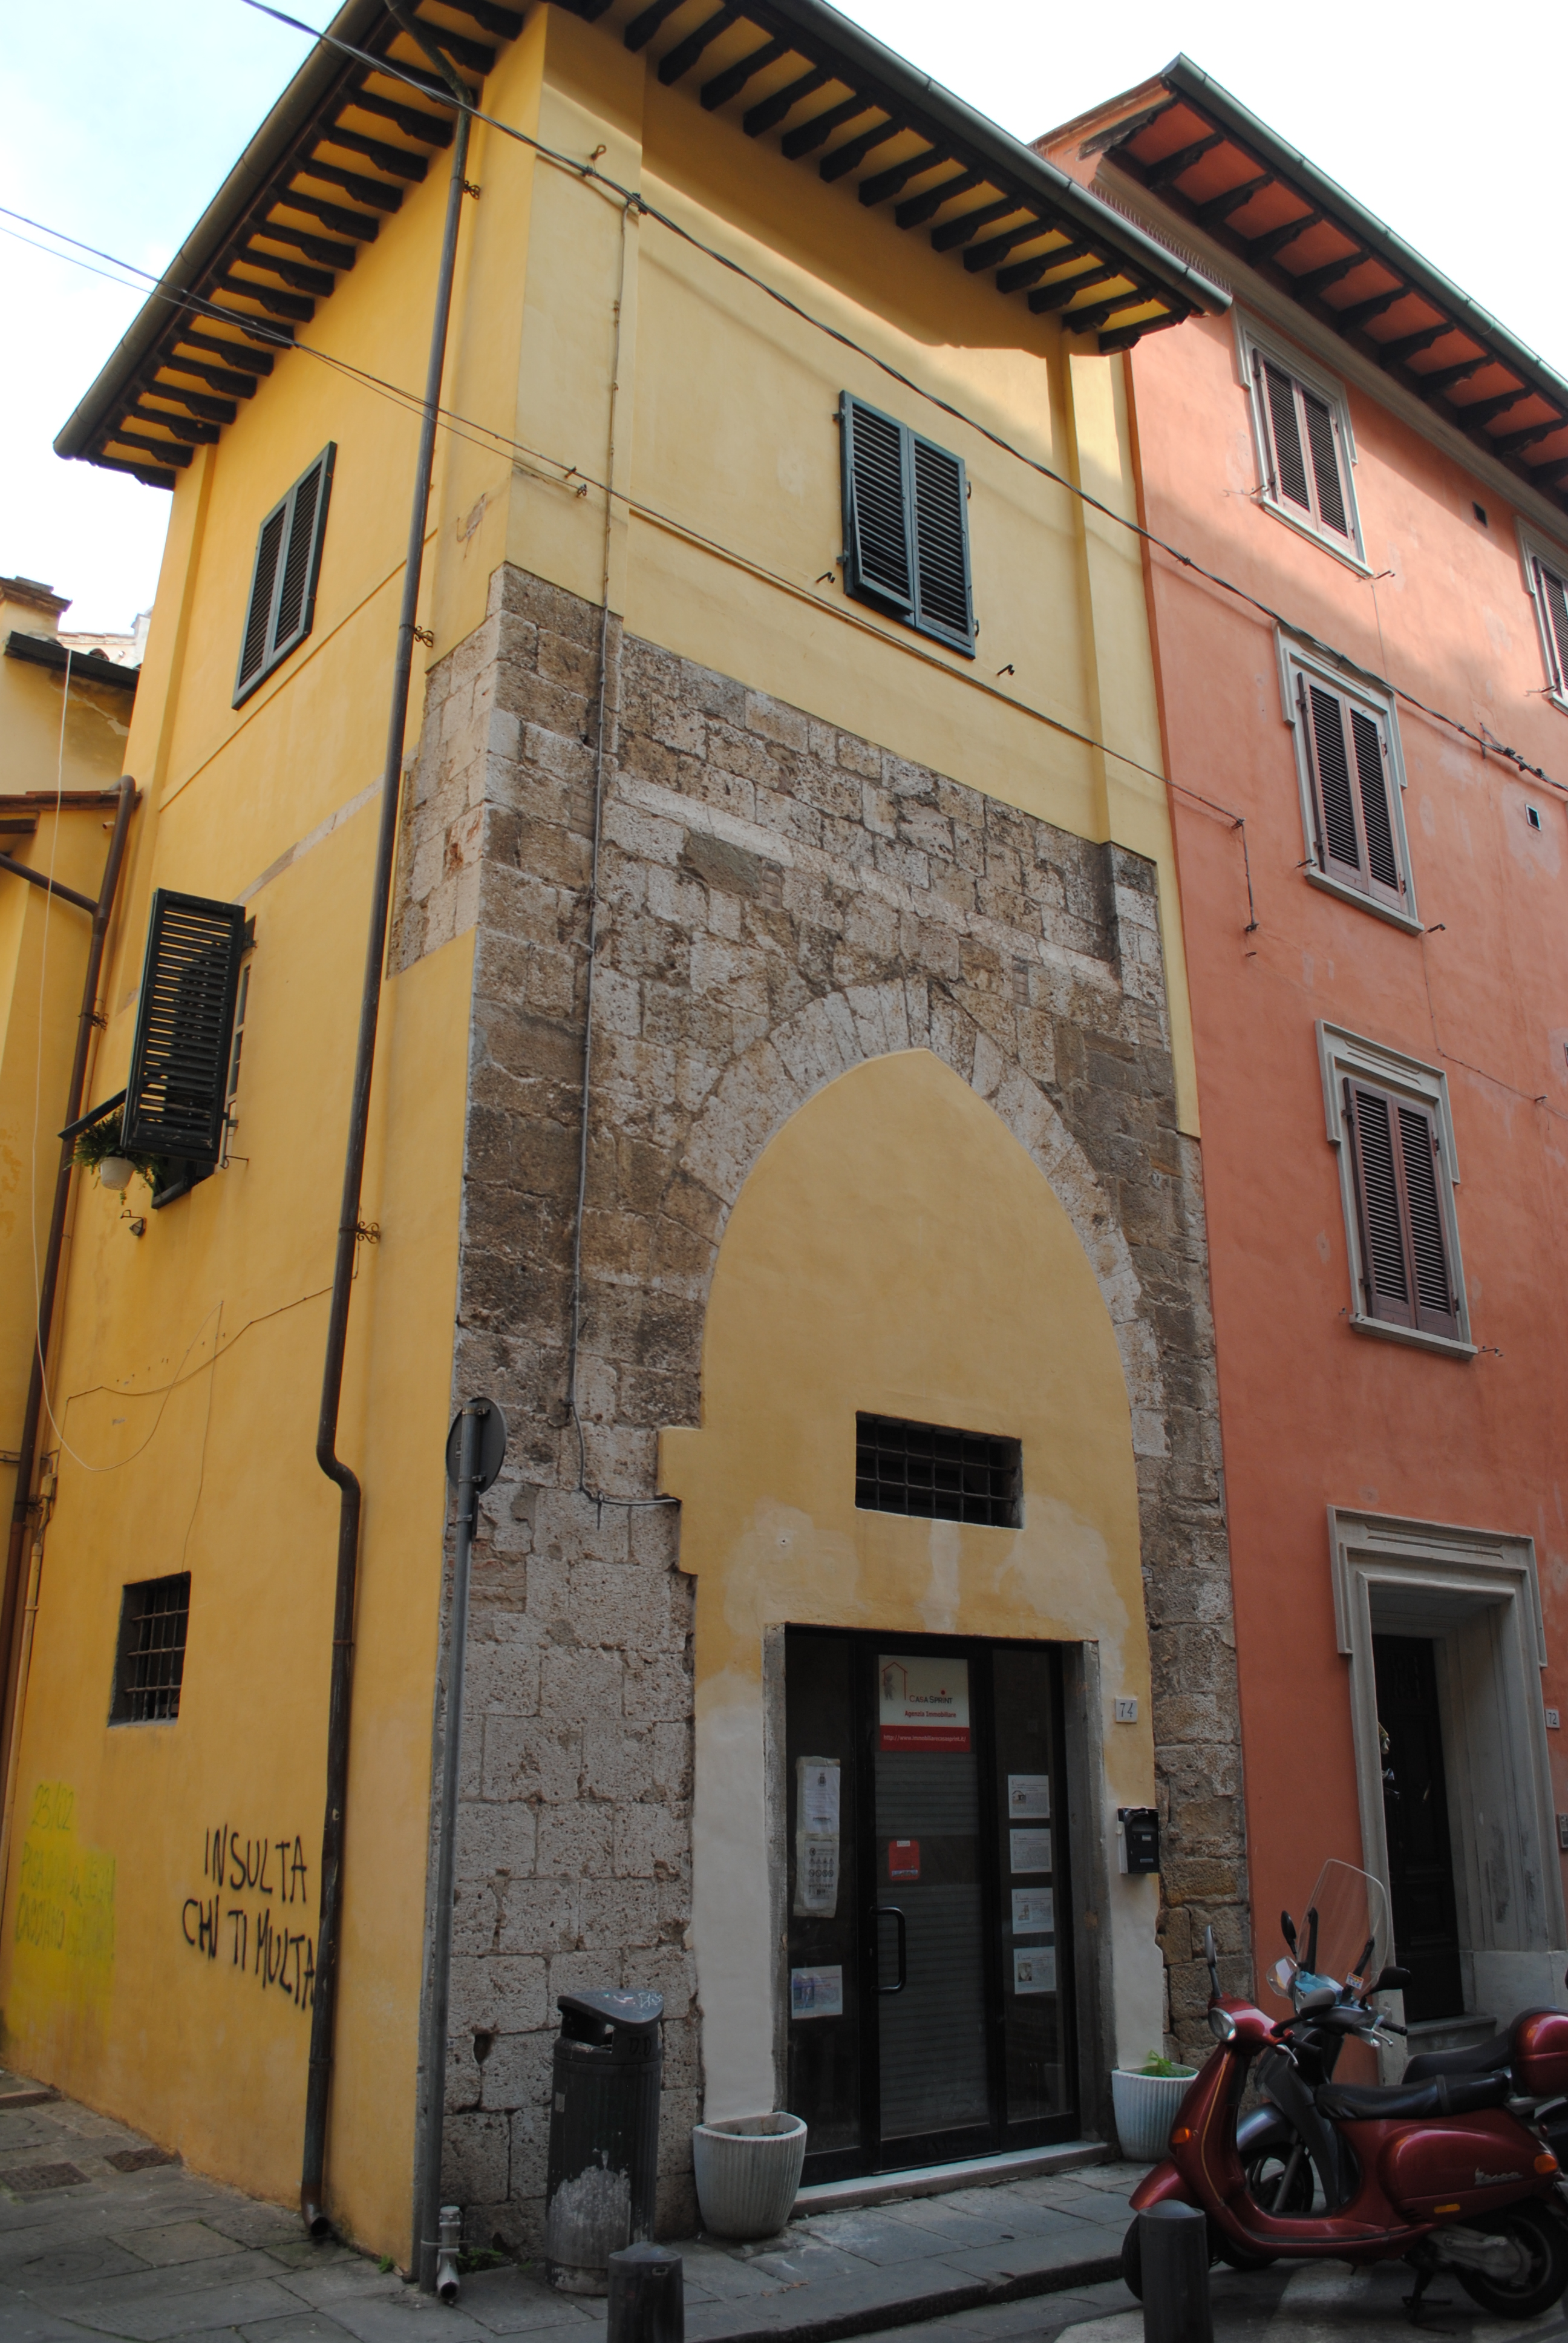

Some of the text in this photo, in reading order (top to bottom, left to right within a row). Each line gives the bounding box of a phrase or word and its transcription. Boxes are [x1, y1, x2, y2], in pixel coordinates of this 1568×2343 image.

[929, 1695, 953, 1703] SPRINT
[1120, 1703, 1133, 1717] 74
[1548, 1712, 1557, 1725] 72
[204, 1823, 308, 1904] INSULTA
[227, 1910, 248, 1971] TI
[255, 1907, 315, 2011] MULTA
